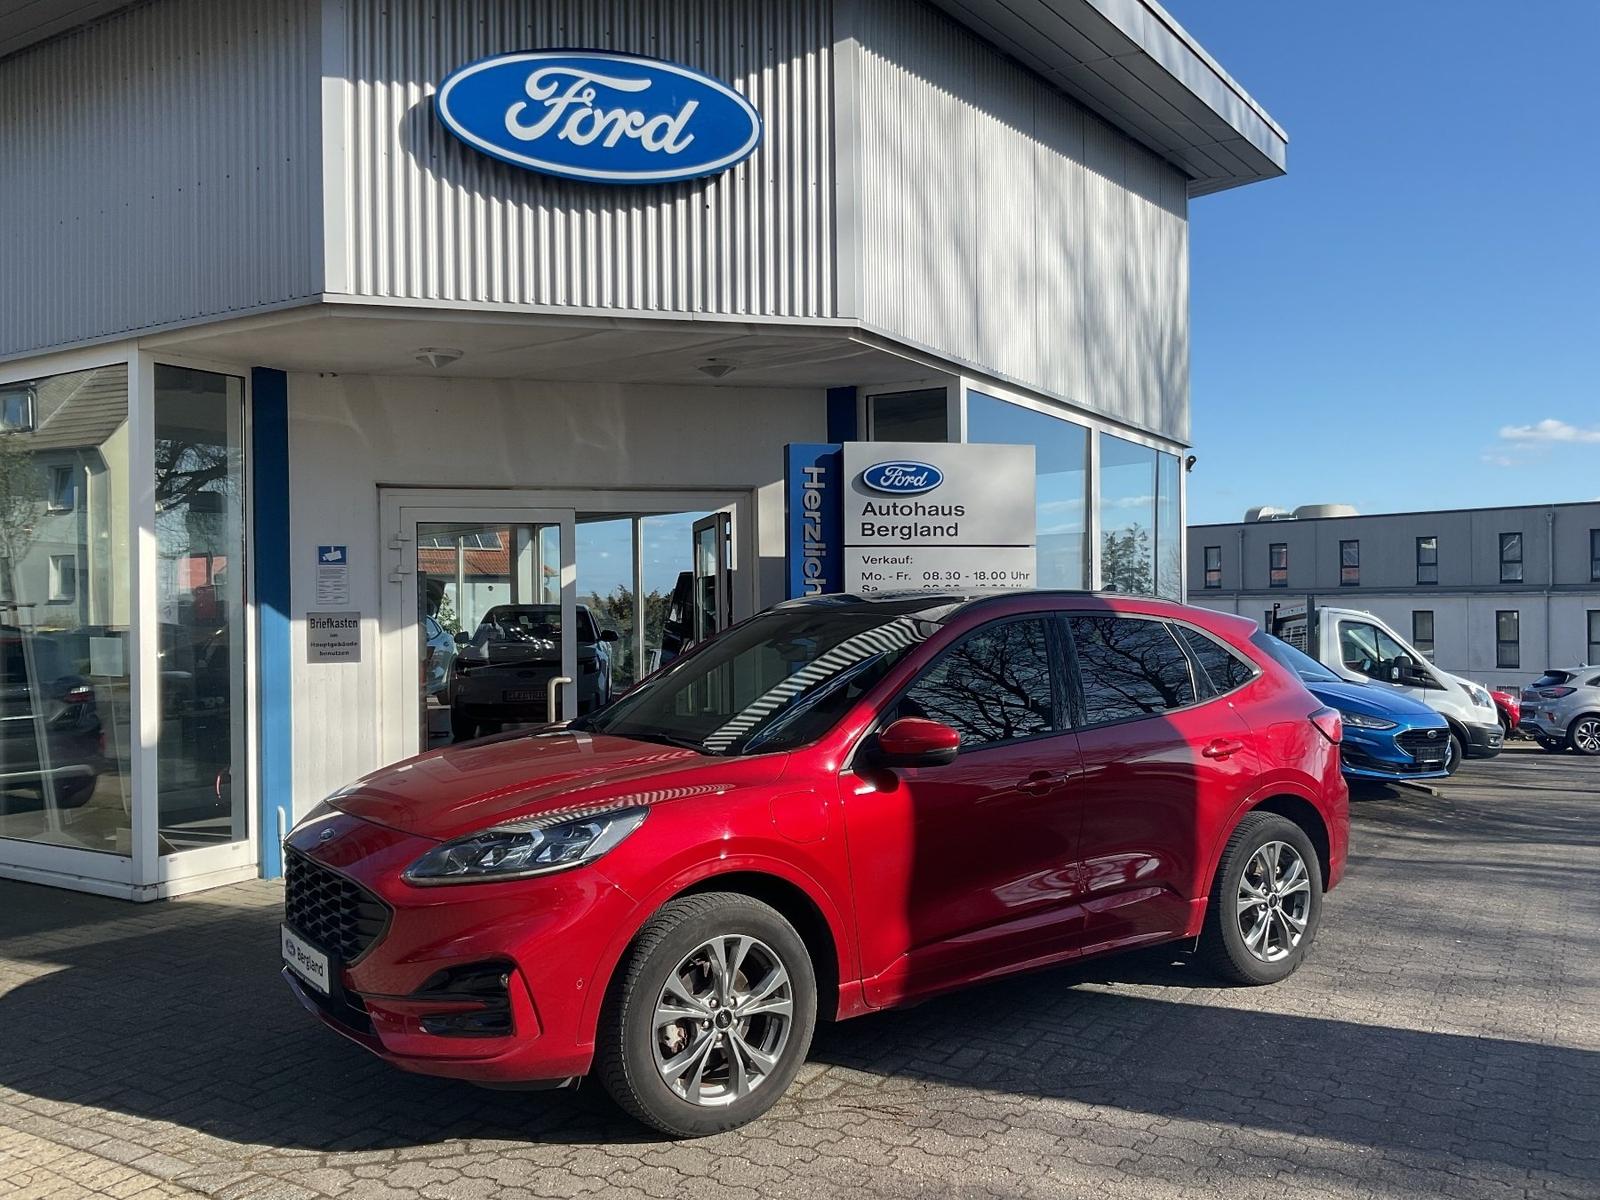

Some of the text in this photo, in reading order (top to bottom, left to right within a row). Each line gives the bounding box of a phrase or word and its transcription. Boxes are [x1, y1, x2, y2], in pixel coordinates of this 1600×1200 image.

[504, 66, 700, 155] Ford
[879, 464, 928, 488] Ford
[861, 501, 965, 517] Autohaus
[803, 466, 826, 597] Herzlich
[861, 522, 958, 540] Bergland
[861, 555, 913, 566] Verkauf:
[861, 571, 886, 581] Mo.
[896, 571, 912, 581] Fr.
[973, 571, 1007, 581] 18.00
[1010, 571, 1031, 581] Uhr
[310, 618, 358, 629] Briefkasten
